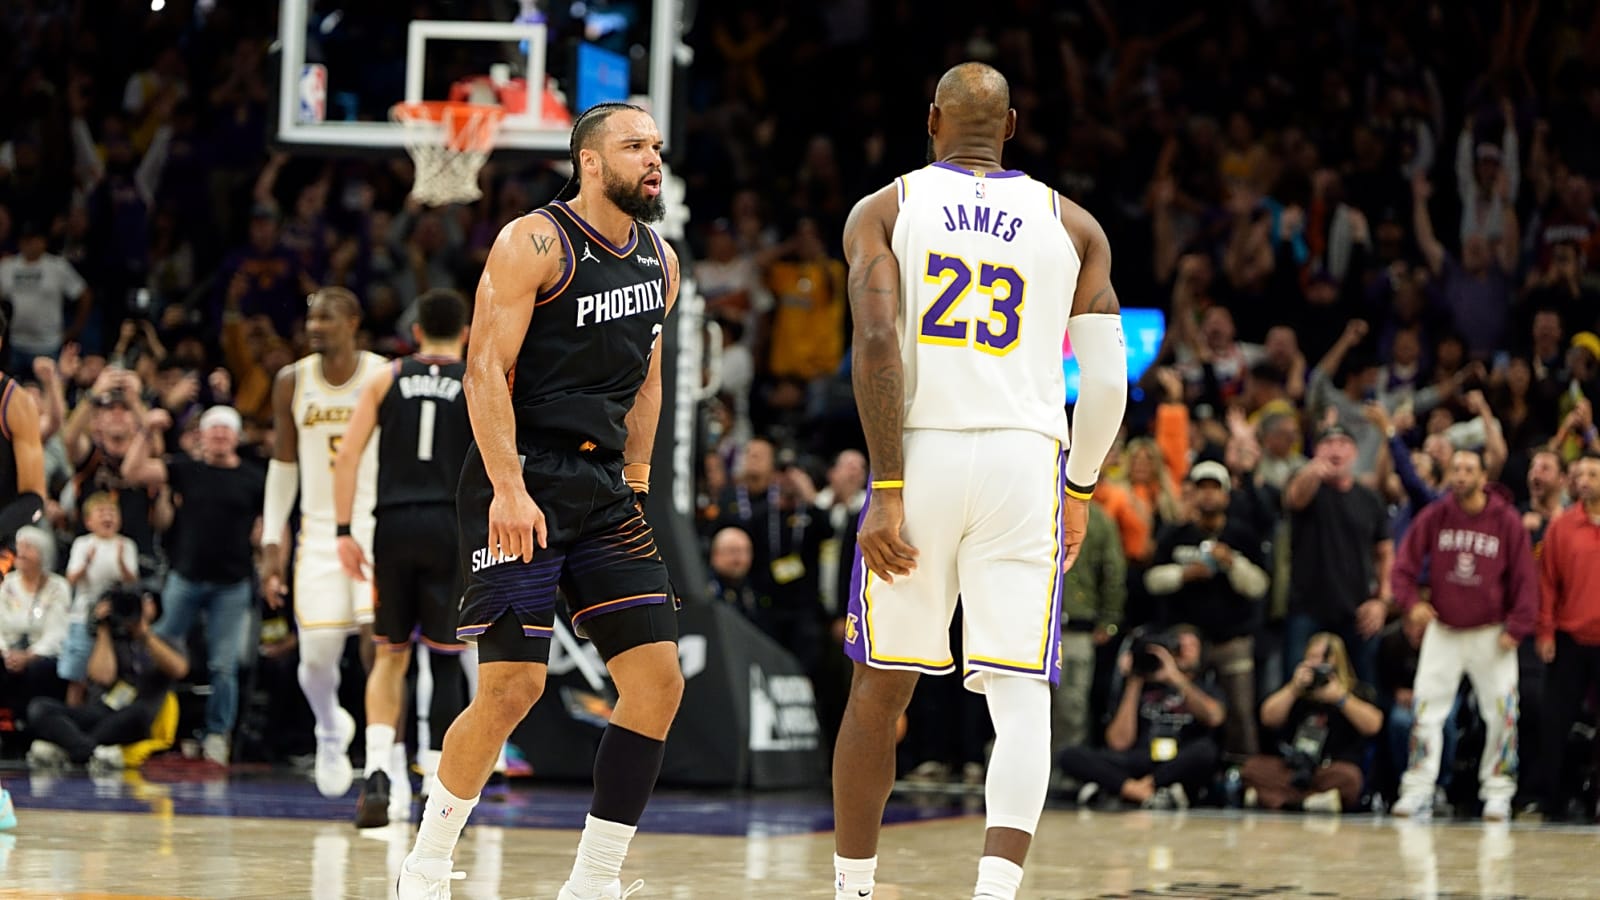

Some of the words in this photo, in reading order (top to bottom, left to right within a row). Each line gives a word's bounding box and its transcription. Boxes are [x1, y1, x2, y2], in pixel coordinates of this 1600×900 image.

[943, 204, 1023, 243] JAMES
[576, 278, 665, 328] PHOENIX
[918, 249, 1027, 357] 23
[417, 399, 437, 462] 1
